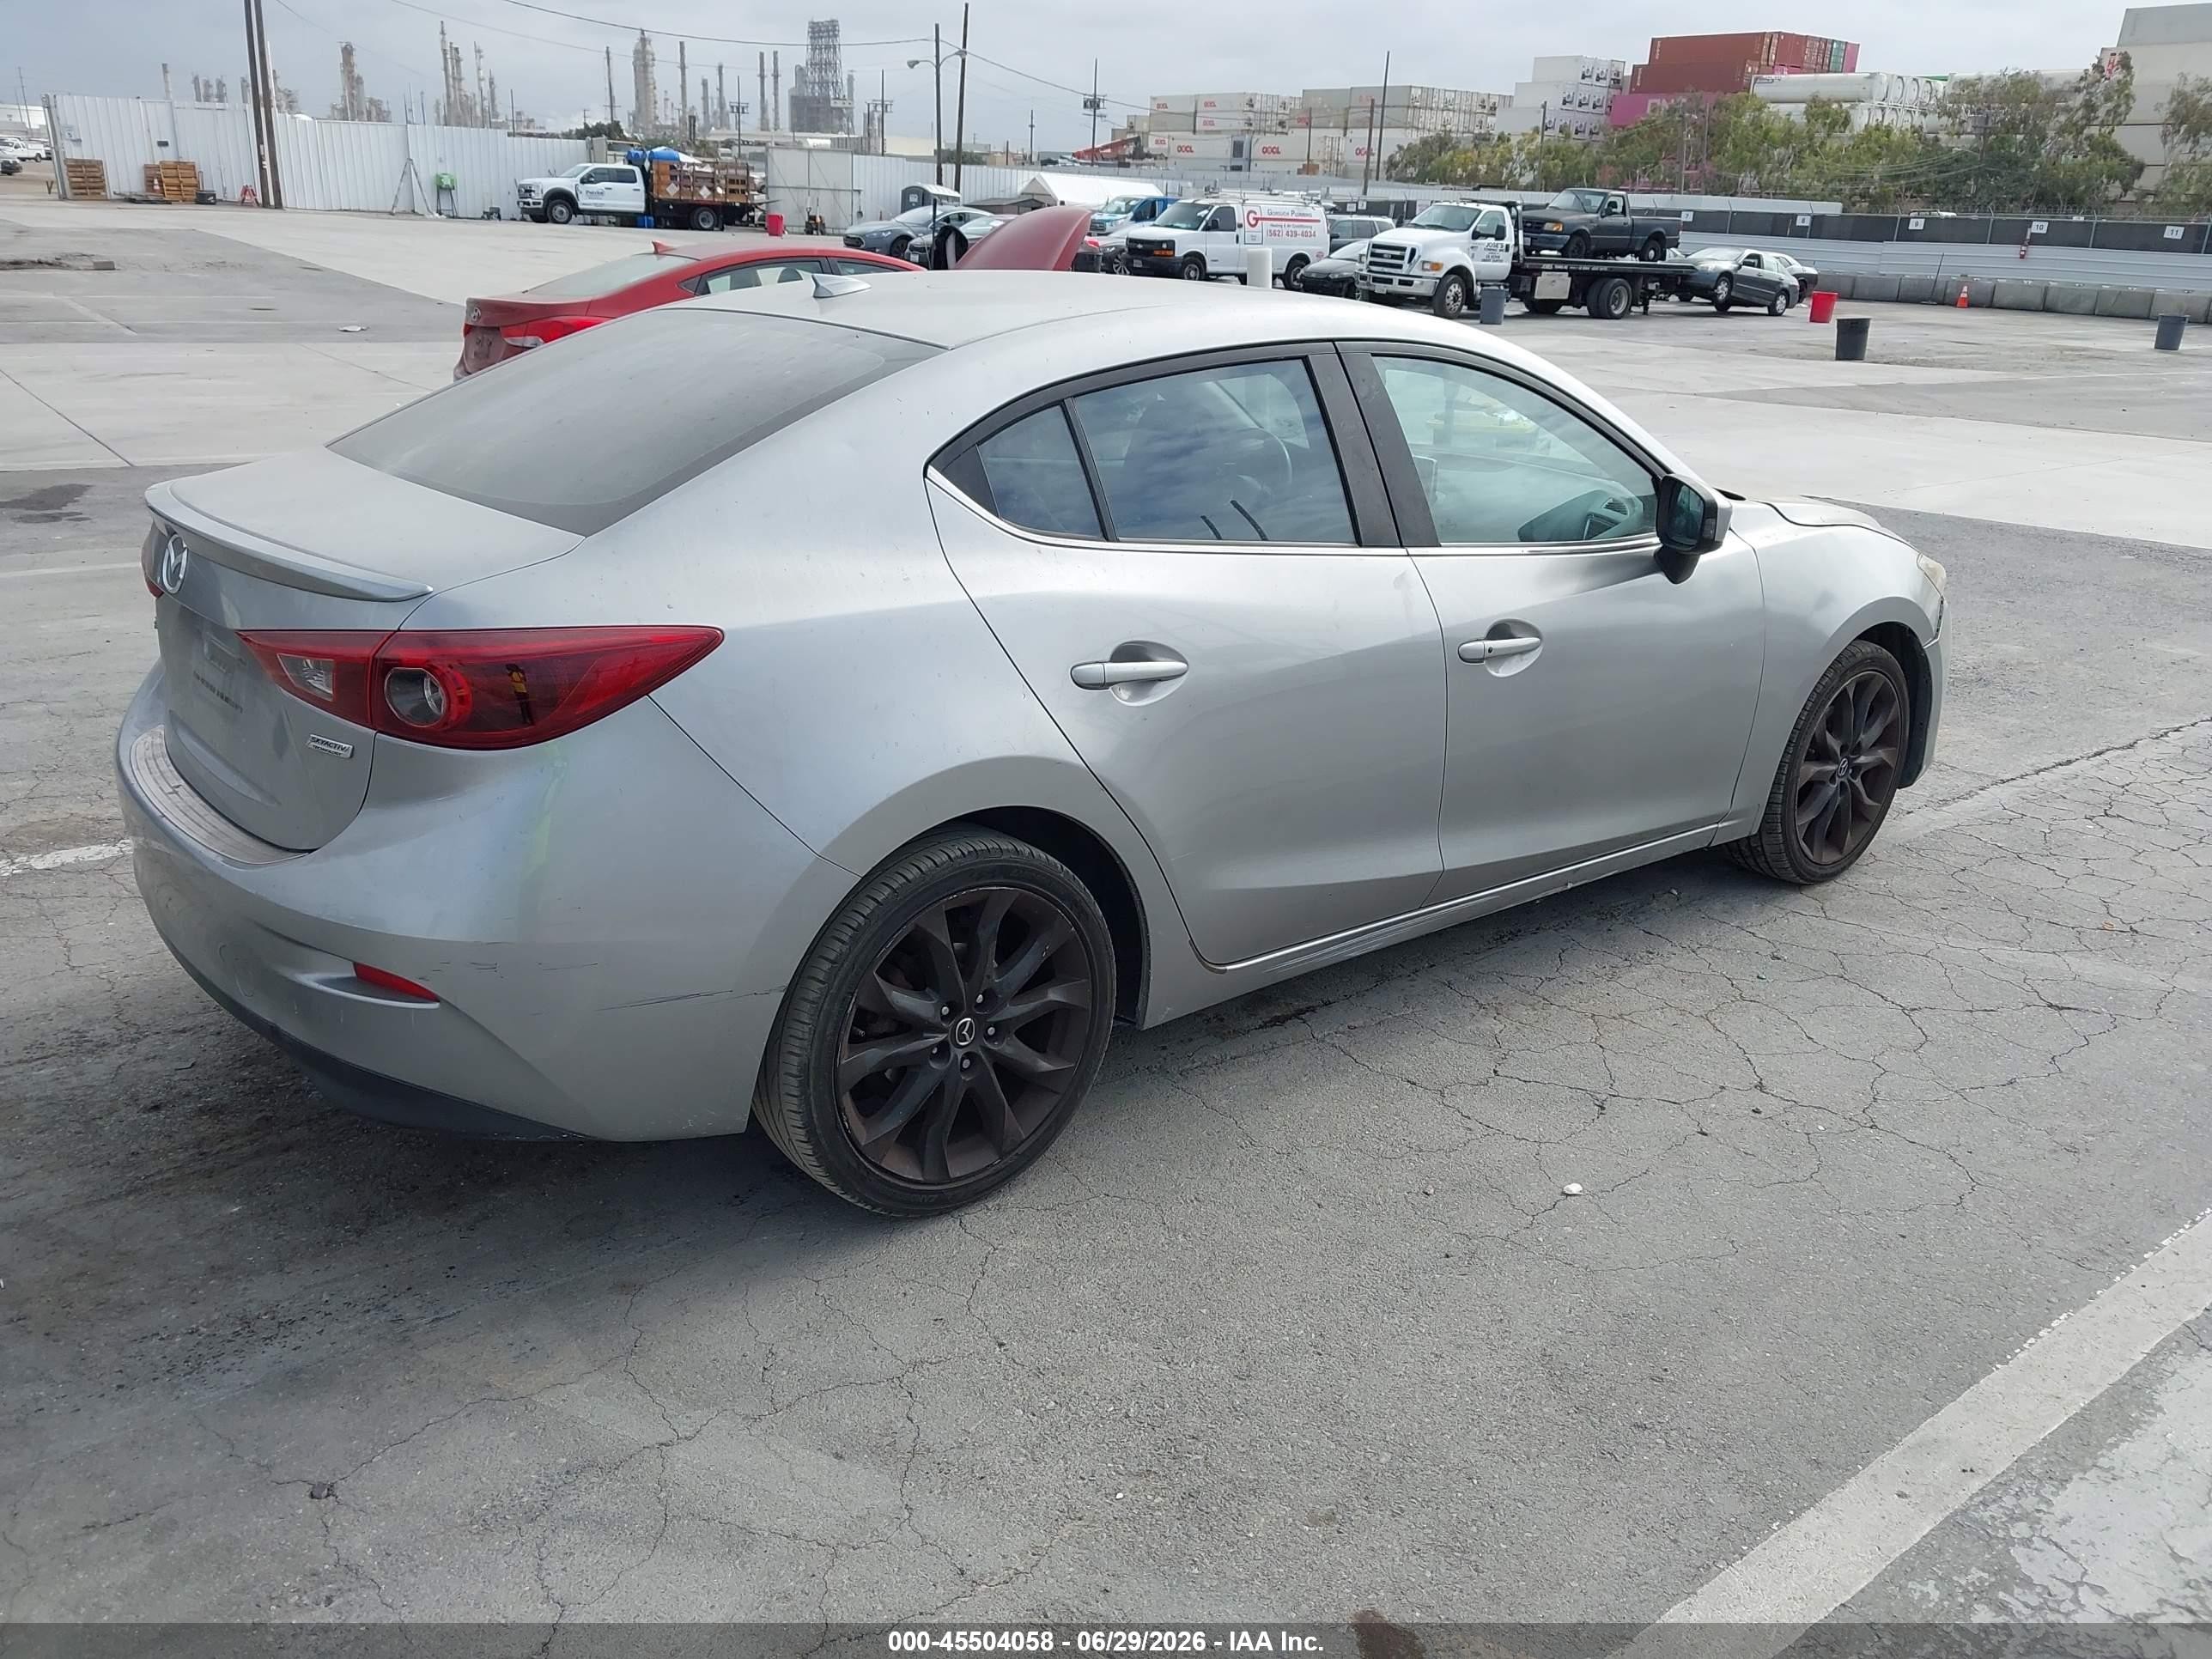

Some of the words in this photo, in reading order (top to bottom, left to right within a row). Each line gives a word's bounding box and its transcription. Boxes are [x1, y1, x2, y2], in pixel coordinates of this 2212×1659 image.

[1261, 146, 1281, 155] OOCL
[1267, 229, 1284, 238] (562)
[311, 737, 350, 752] SKYACTIV
